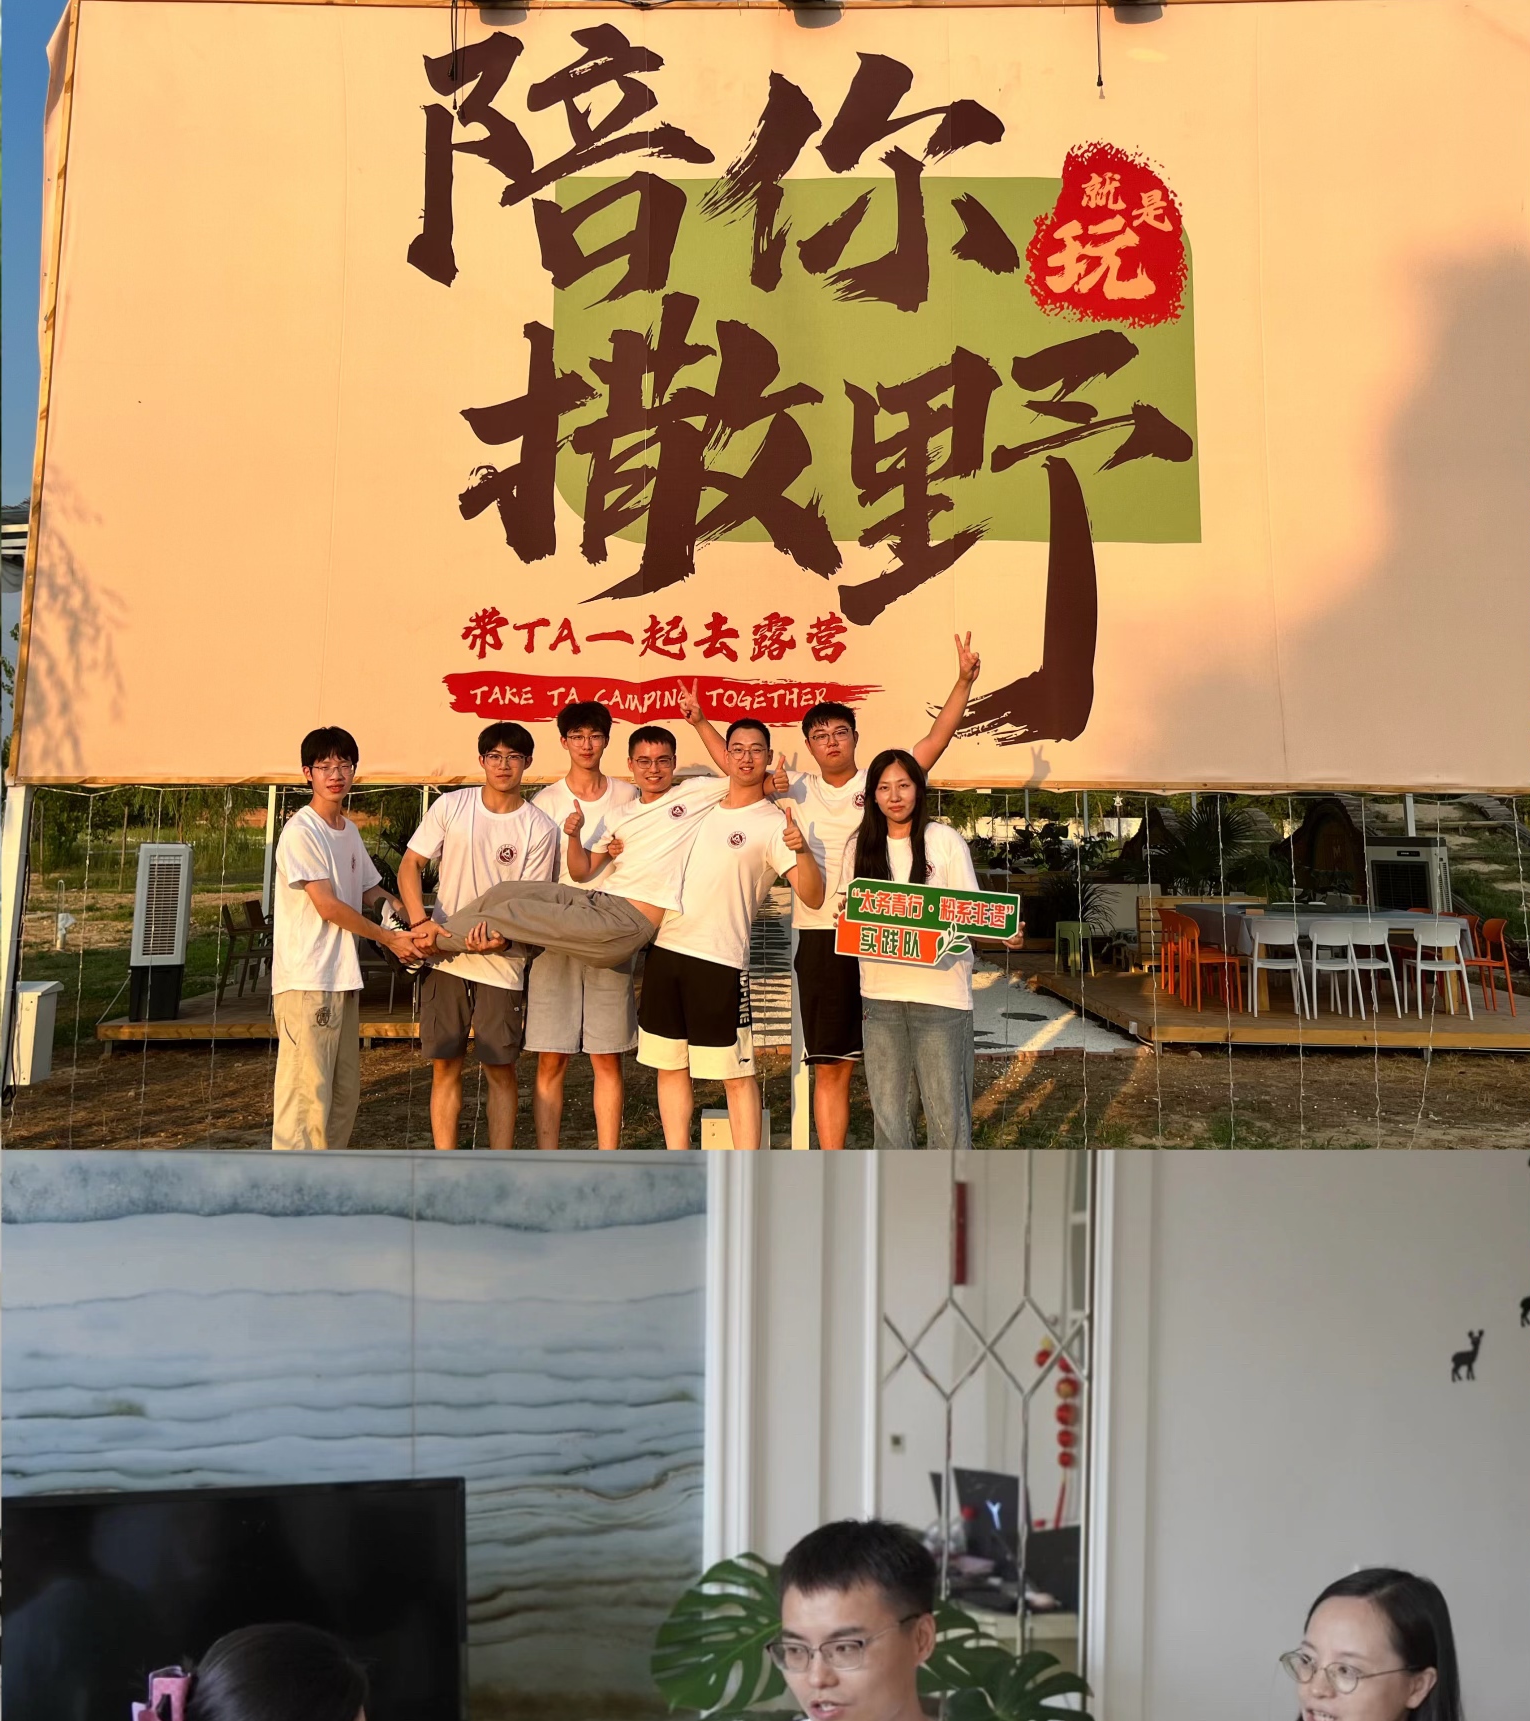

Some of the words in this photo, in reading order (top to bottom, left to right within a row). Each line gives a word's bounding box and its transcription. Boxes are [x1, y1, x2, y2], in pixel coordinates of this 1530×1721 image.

[406, 23, 1020, 314] 陪你
[1080, 171, 1182, 234] 就是
[1046, 221, 1157, 302] 玩
[458, 292, 1194, 745] 撒野
[459, 607, 849, 663] 带TA一起去露营
[470, 684, 535, 706] TAKE
[546, 684, 581, 706] TA
[705, 685, 828, 709] TOGETHER
[859, 926, 920, 958] 实践队
